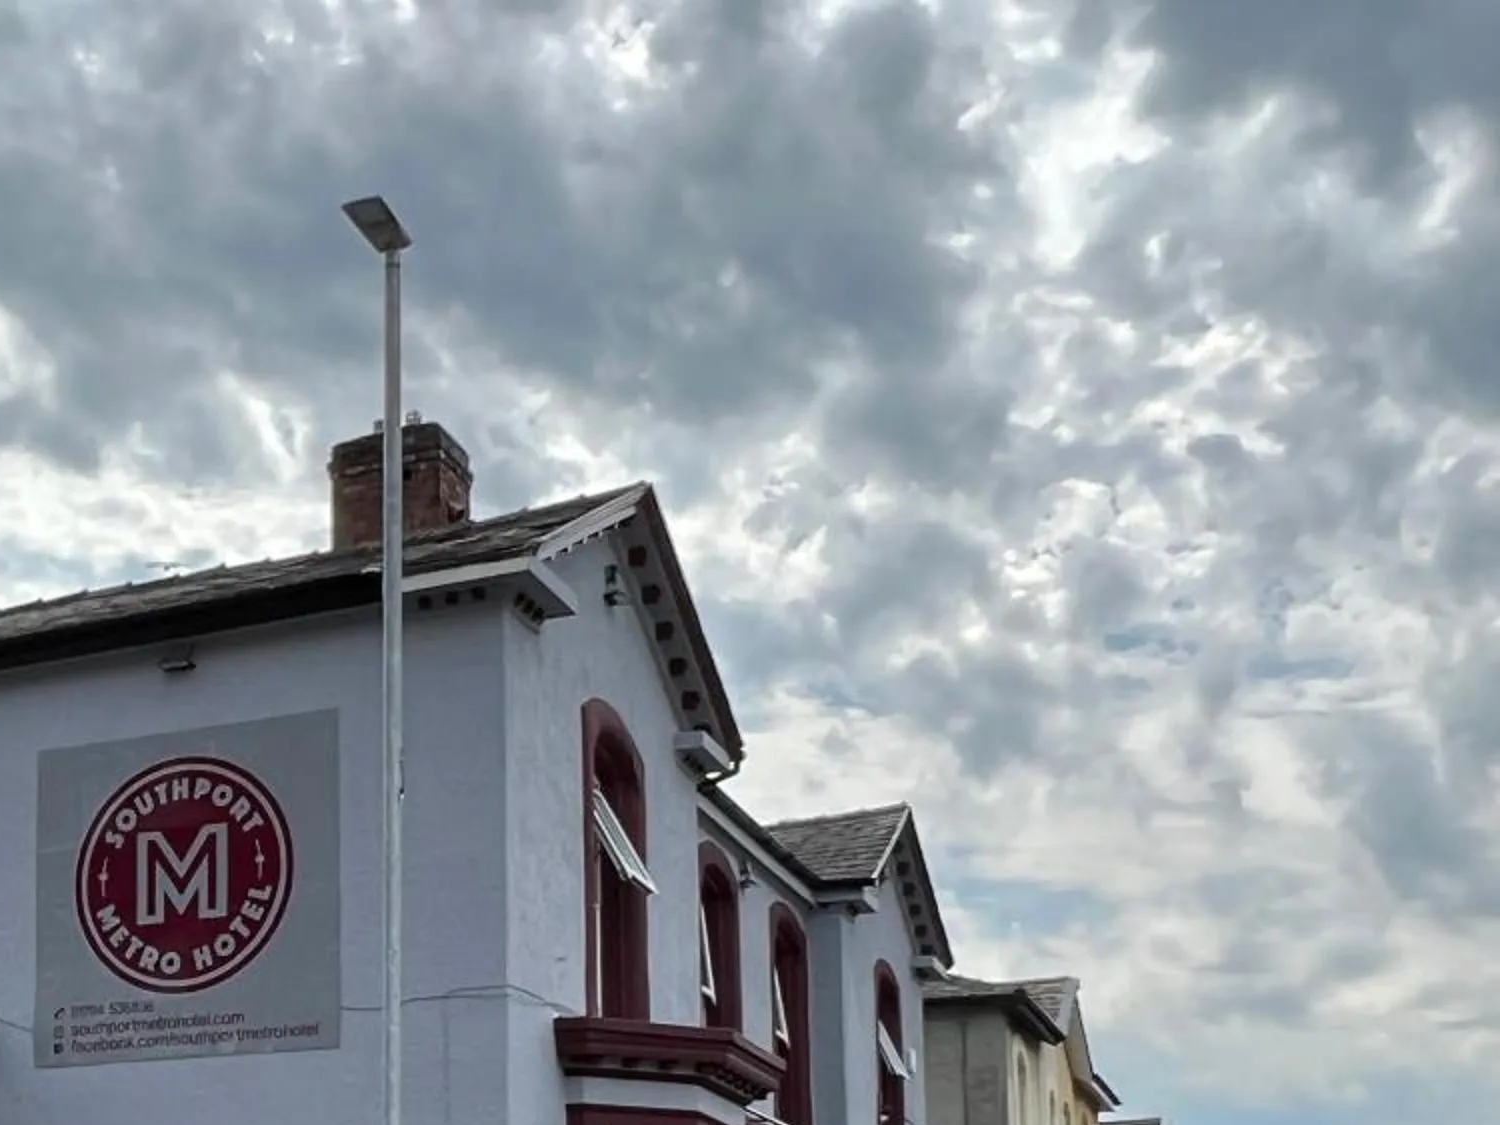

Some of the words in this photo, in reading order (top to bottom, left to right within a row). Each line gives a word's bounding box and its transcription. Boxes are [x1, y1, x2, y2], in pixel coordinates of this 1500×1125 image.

[105, 777, 265, 849] SOUTHPORT
[136, 823, 228, 925] M
[97, 903, 181, 974] METRO
[193, 885, 273, 970] HOTEL
